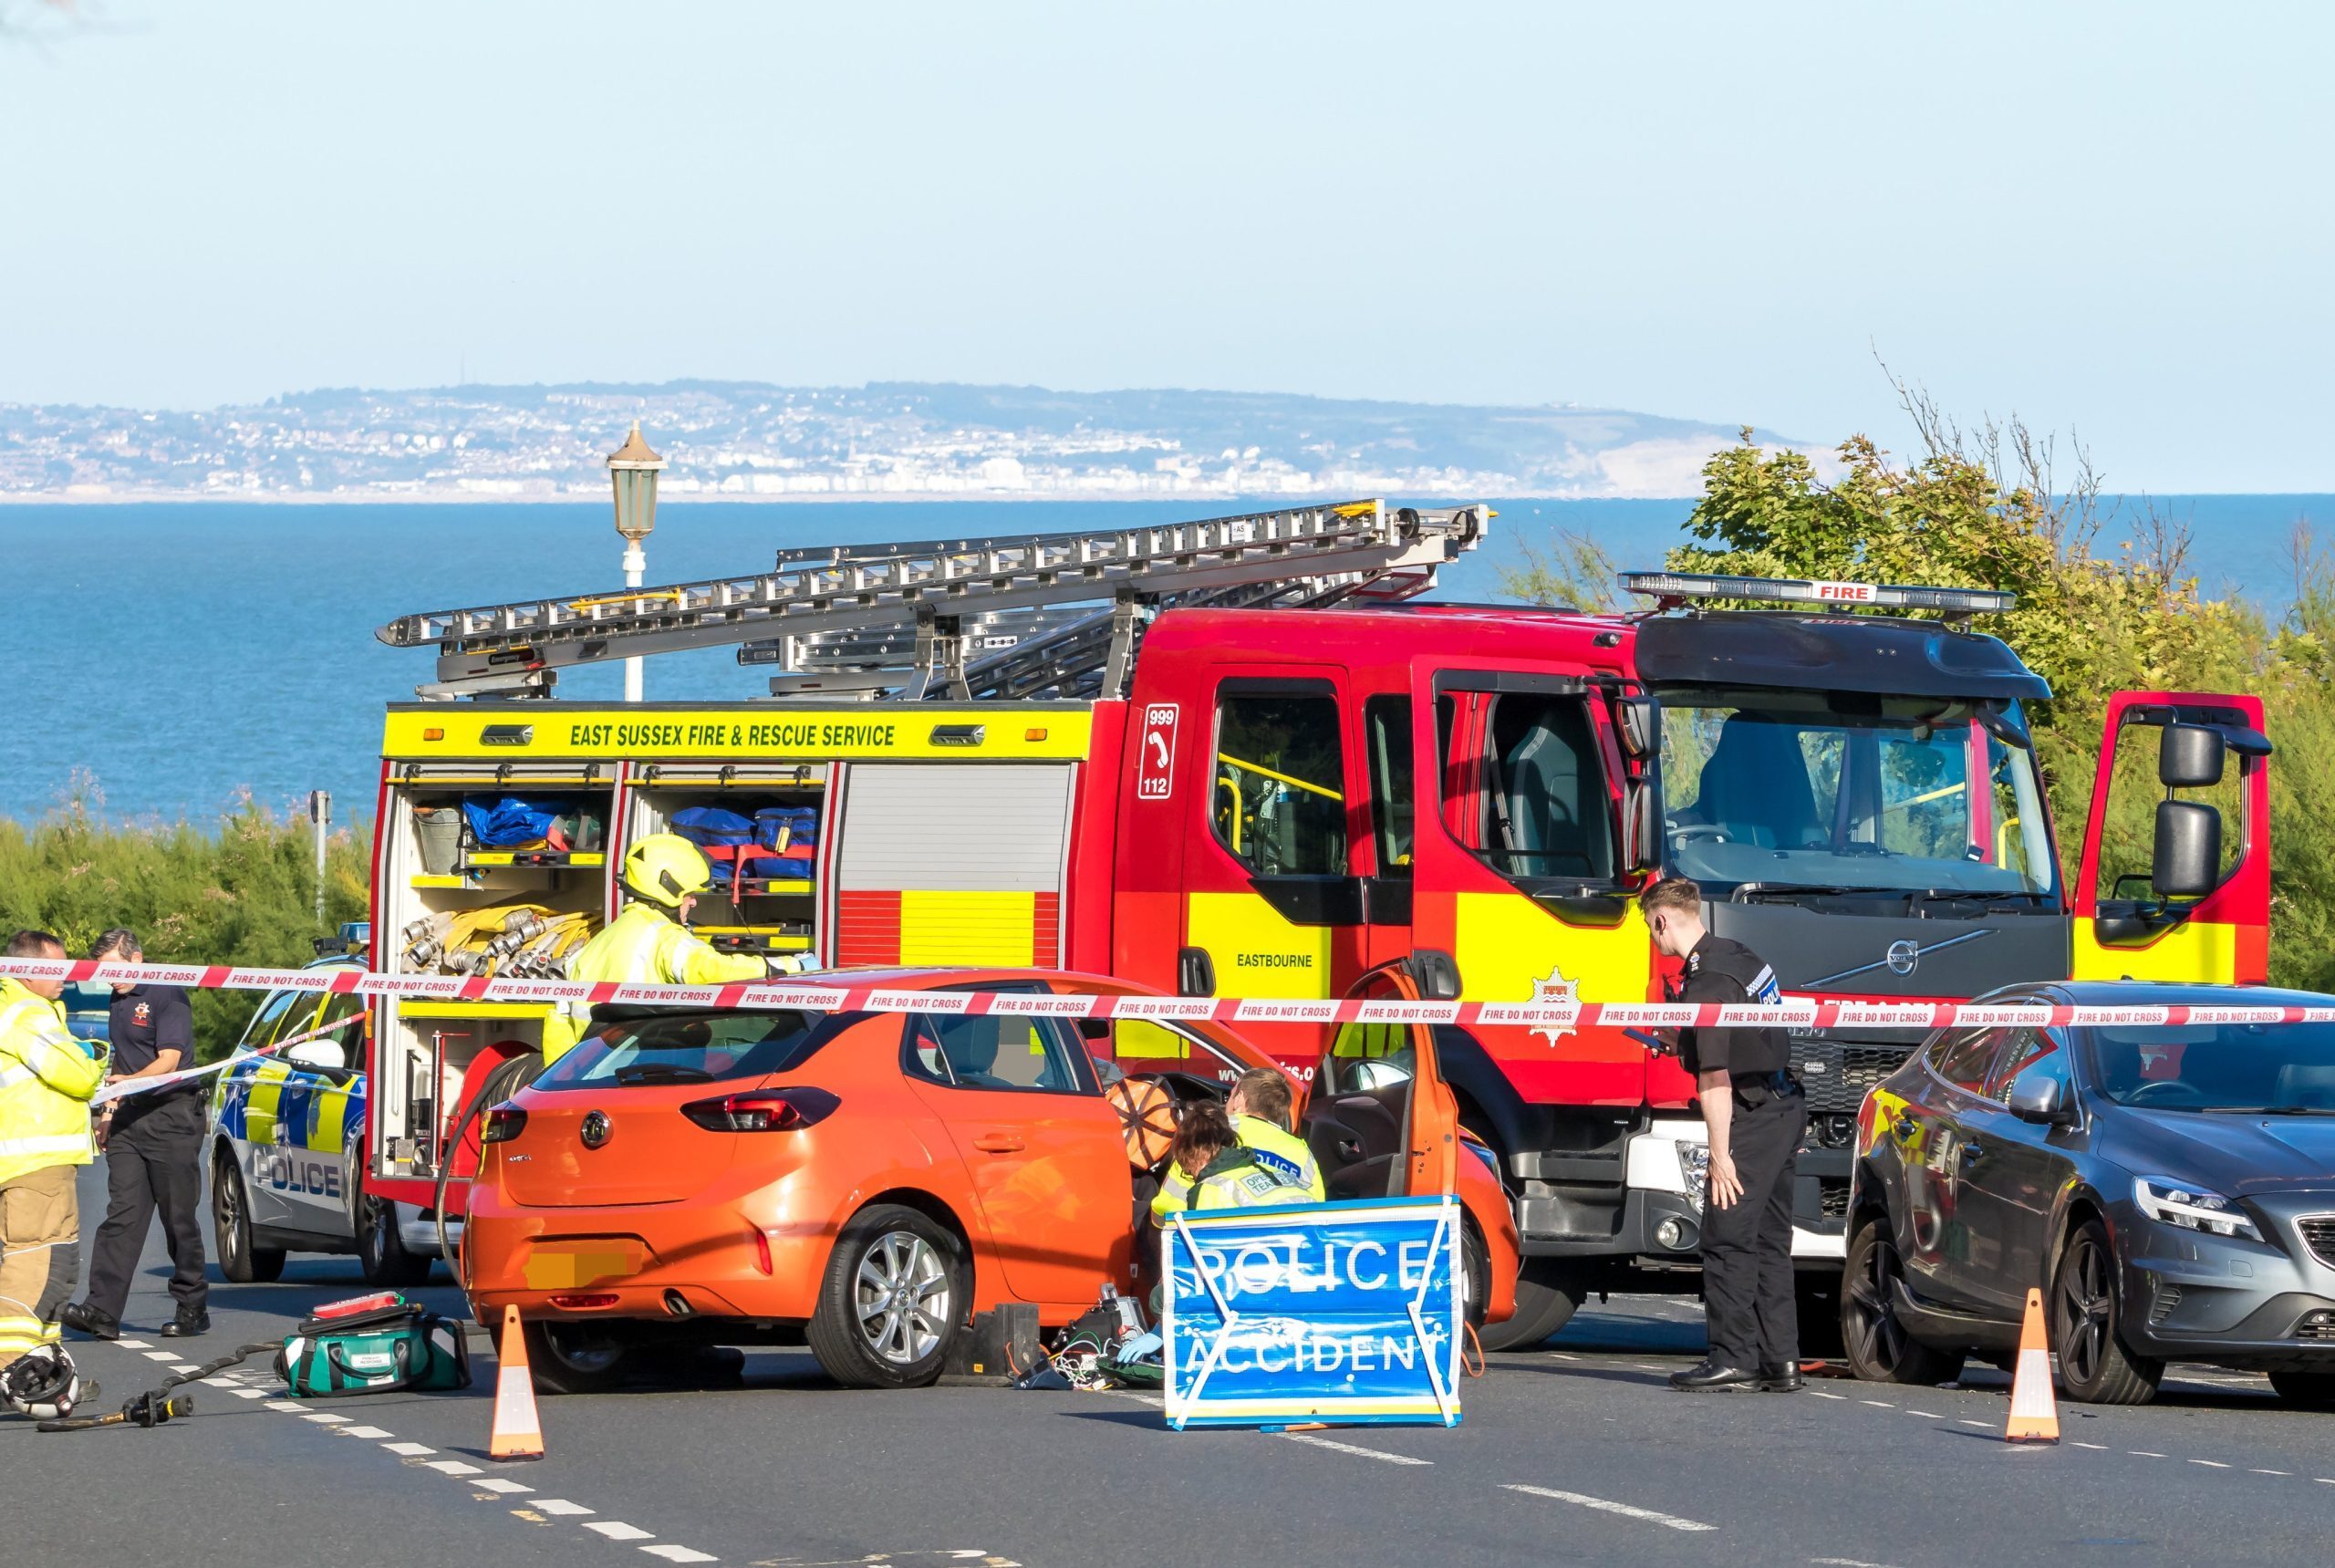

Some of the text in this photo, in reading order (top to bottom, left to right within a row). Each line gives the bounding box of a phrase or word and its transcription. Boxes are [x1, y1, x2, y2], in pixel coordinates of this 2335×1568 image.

[1821, 587, 1868, 599] FIRE
[1149, 710, 1175, 726] 999
[570, 725, 895, 746] EAST SUSSEX FIRE & RESCUE SERVICE
[1144, 777, 1168, 794] 112
[1237, 954, 1312, 967] EASTBOURNE
[7, 965, 29, 974] NOT
[31, 966, 64, 976] CROSS
[100, 969, 196, 981] FIRE DO NOT CROSS
[232, 975, 327, 987] FIRE DO NOT CROSS
[363, 980, 457, 992] FIRE DO NOT CROSS
[493, 985, 585, 996] FIRE DO NOT CROSS
[620, 990, 711, 1001] FIRE DO NOT CROSS
[746, 993, 837, 1004] FIRE DO NOT CROSS
[872, 997, 962, 1009] FIRE DO NOT CROSS
[996, 1001, 1085, 1012] FIRE DO NOT CROSS
[1119, 1003, 1209, 1014] FIRE DO NOT CROSS
[1242, 1006, 1331, 1017] FIRE DO NOT CROSS
[1365, 1008, 1452, 1019] FIRE DO NOT CROSS
[1485, 1010, 1572, 1020] FIRE DO NOT CROSS
[1605, 1011, 1691, 1021] FIRE DO NOT CROSS
[1724, 1012, 1810, 1022] FIRE DO NOT CROSS
[1842, 1012, 1927, 1023] FIRE DO NOT CROSS
[1961, 1012, 2045, 1023] FIRE DO NOT CROSS
[2078, 1012, 2162, 1023] FIRE DO NOT CROSS
[2195, 1012, 2278, 1022] FIRE DO NOT CROSS
[2309, 1012, 2330, 1021] FIRE
[1256, 1153, 1299, 1179] OLICE
[256, 1155, 340, 1198] POLICE
[1194, 1241, 1430, 1296] POLICE
